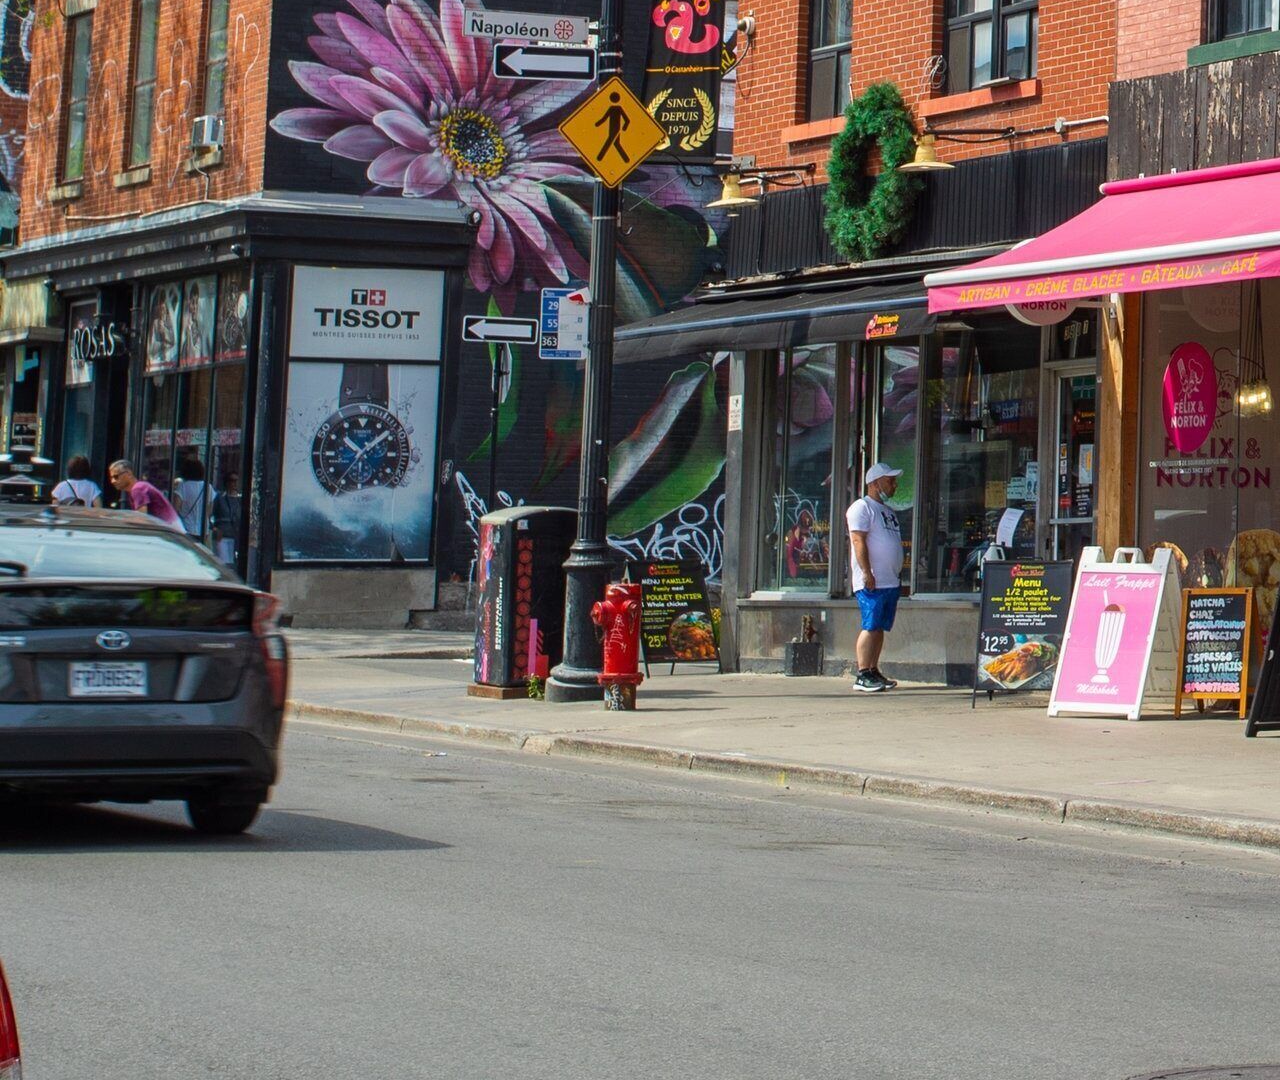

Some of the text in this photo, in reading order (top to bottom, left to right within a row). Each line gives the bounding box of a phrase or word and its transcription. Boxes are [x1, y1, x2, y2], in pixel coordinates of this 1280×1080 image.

[471, 19, 549, 38] Napoléon
[666, 98, 697, 108] SINCE
[661, 111, 699, 122] DEPUIS
[668, 125, 690, 135] 1970
[957, 252, 1259, 304] ARTISAN CRÈME GLACÉE GÂTEAUX CAFÉ
[548, 301, 559, 310] 29
[1021, 300, 1067, 311] NORTON
[314, 308, 420, 330] TISSOT
[547, 319, 558, 328] 55
[312, 331, 345, 339] MONTRES
[347, 331, 376, 339] SUISSES
[378, 332, 403, 340] DEPUIS
[542, 336, 558, 346] 363
[1174, 400, 1195, 414] FÉLIX
[1170, 415, 1207, 428] NORTON
[1156, 466, 1271, 489] NORTON
[1014, 577, 1042, 588] Menu
[1083, 574, 1156, 591] Lait Frappé
[646, 592, 702, 601] POULET ENTIER
[1006, 588, 1049, 598] 1/2 poulet
[1190, 597, 1225, 608] MATCHA
[1189, 610, 1214, 620] CHAI
[1187, 651, 1233, 664] ESPRESSO
